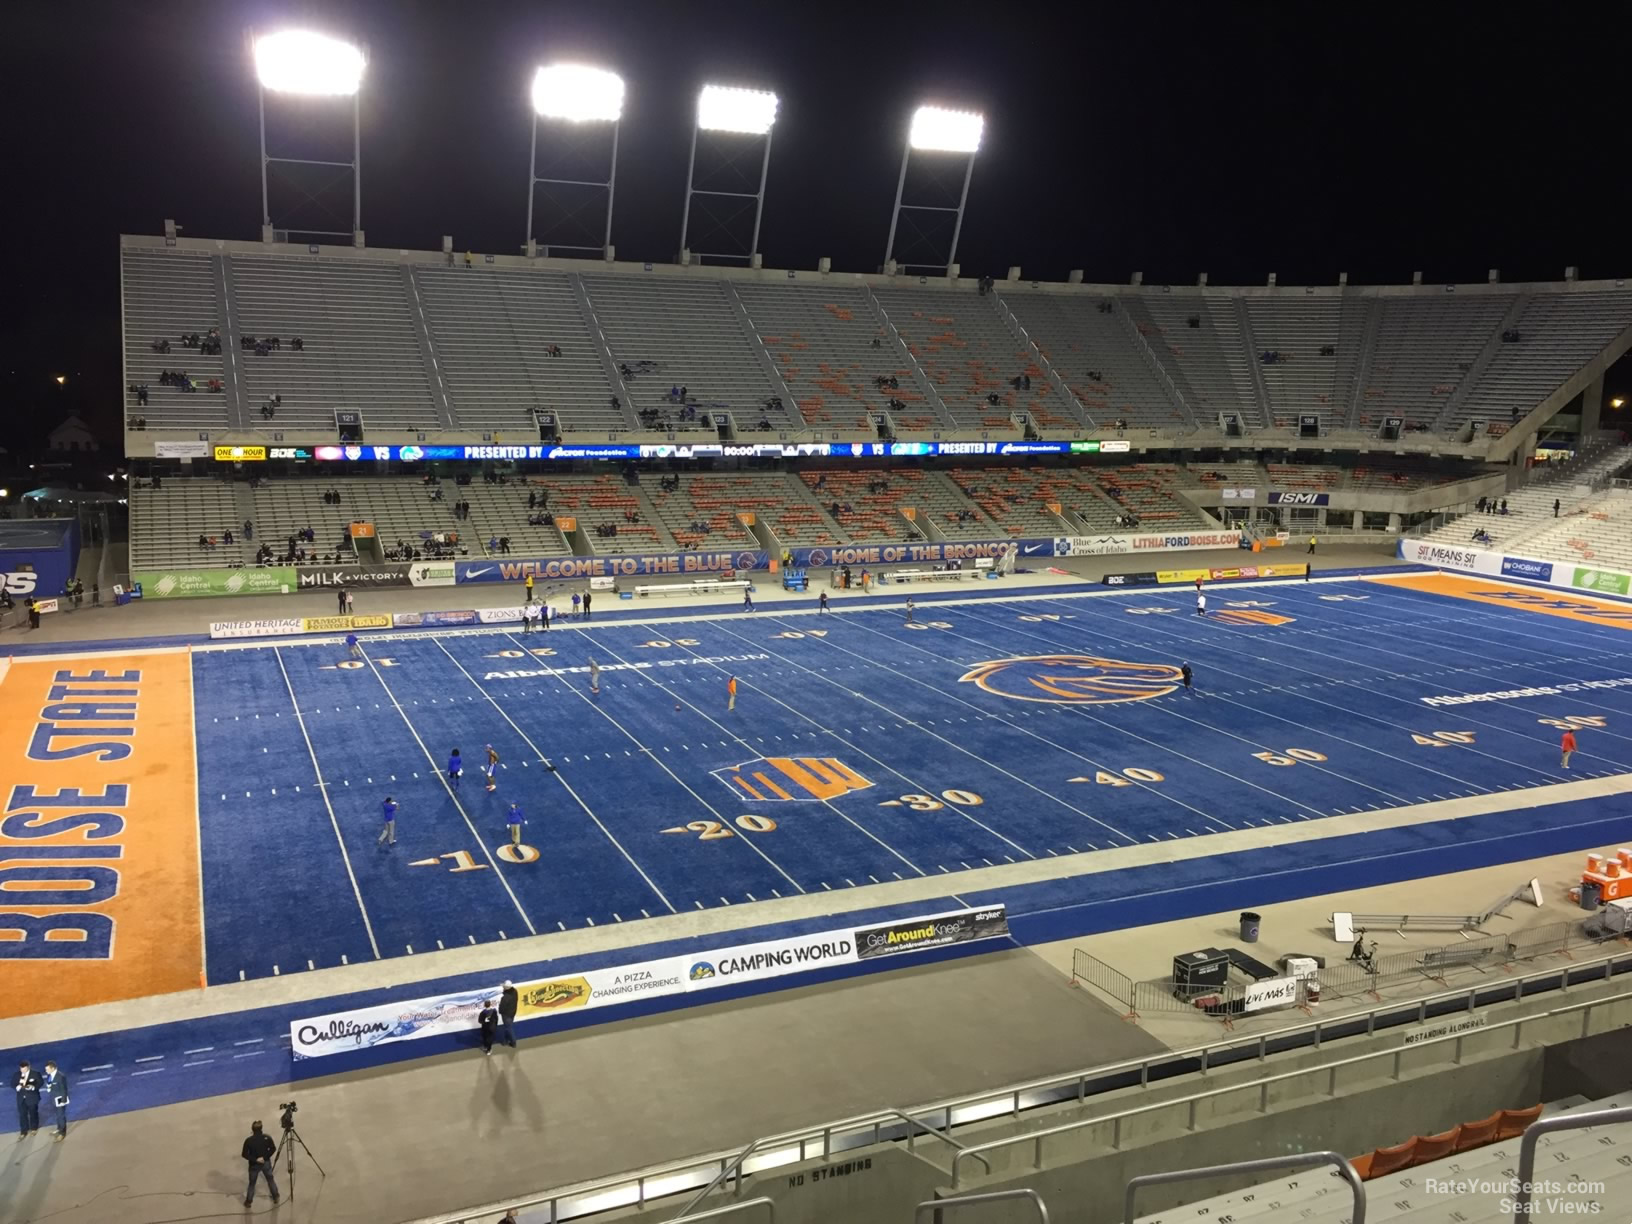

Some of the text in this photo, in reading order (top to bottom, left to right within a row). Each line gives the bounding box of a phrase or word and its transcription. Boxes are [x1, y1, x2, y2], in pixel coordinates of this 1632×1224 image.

[373, 446, 390, 460] VS
[464, 446, 543, 459] PRESENTED BY
[586, 449, 628, 457] Foundation
[872, 443, 884, 456] VS
[938, 443, 997, 455] PRESENTED BY
[1278, 492, 1319, 504] ISMI
[561, 521, 570, 529] 22
[1073, 537, 1091, 547] Blue
[1132, 534, 1241, 549] LITHIAFORDBOISE.COM
[831, 542, 1019, 564] HOME OF THE BRONCOS
[1072, 545, 1127, 555] Cross of Idaho
[1417, 545, 1478, 565] SIT MEANS SIT
[500, 554, 733, 580] WELCOME TO THE BLUE
[180, 575, 203, 583] Idaho
[249, 572, 272, 580] Idaho
[249, 578, 279, 587] Central
[301, 572, 399, 586] MILK VICTORY
[180, 581, 211, 590] Central
[307, 617, 350, 625] FAMOUS
[487, 609, 517, 619] ZIONS
[214, 618, 301, 632] UNITED HERITAGE
[223, 627, 295, 637] INSURANCE
[307, 622, 350, 630] POTATOES
[657, 653, 770, 667] STADIUM
[25, 669, 143, 762] STATE
[1251, 747, 1329, 767] 50
[1095, 767, 1166, 788] 40
[899, 789, 984, 812] 30
[686, 814, 778, 841] 20
[440, 843, 542, 874] 10
[0, 783, 131, 961] BOISE
[975, 910, 1001, 923] stryker
[718, 940, 852, 976] CAMPING WORLD
[614, 970, 653, 984] A PIZZA
[592, 985, 633, 999] CHANGING
[1245, 991, 1265, 1005] LIVE
[298, 1020, 389, 1046] Culligan
[788, 1158, 873, 1189] NO STANDING
